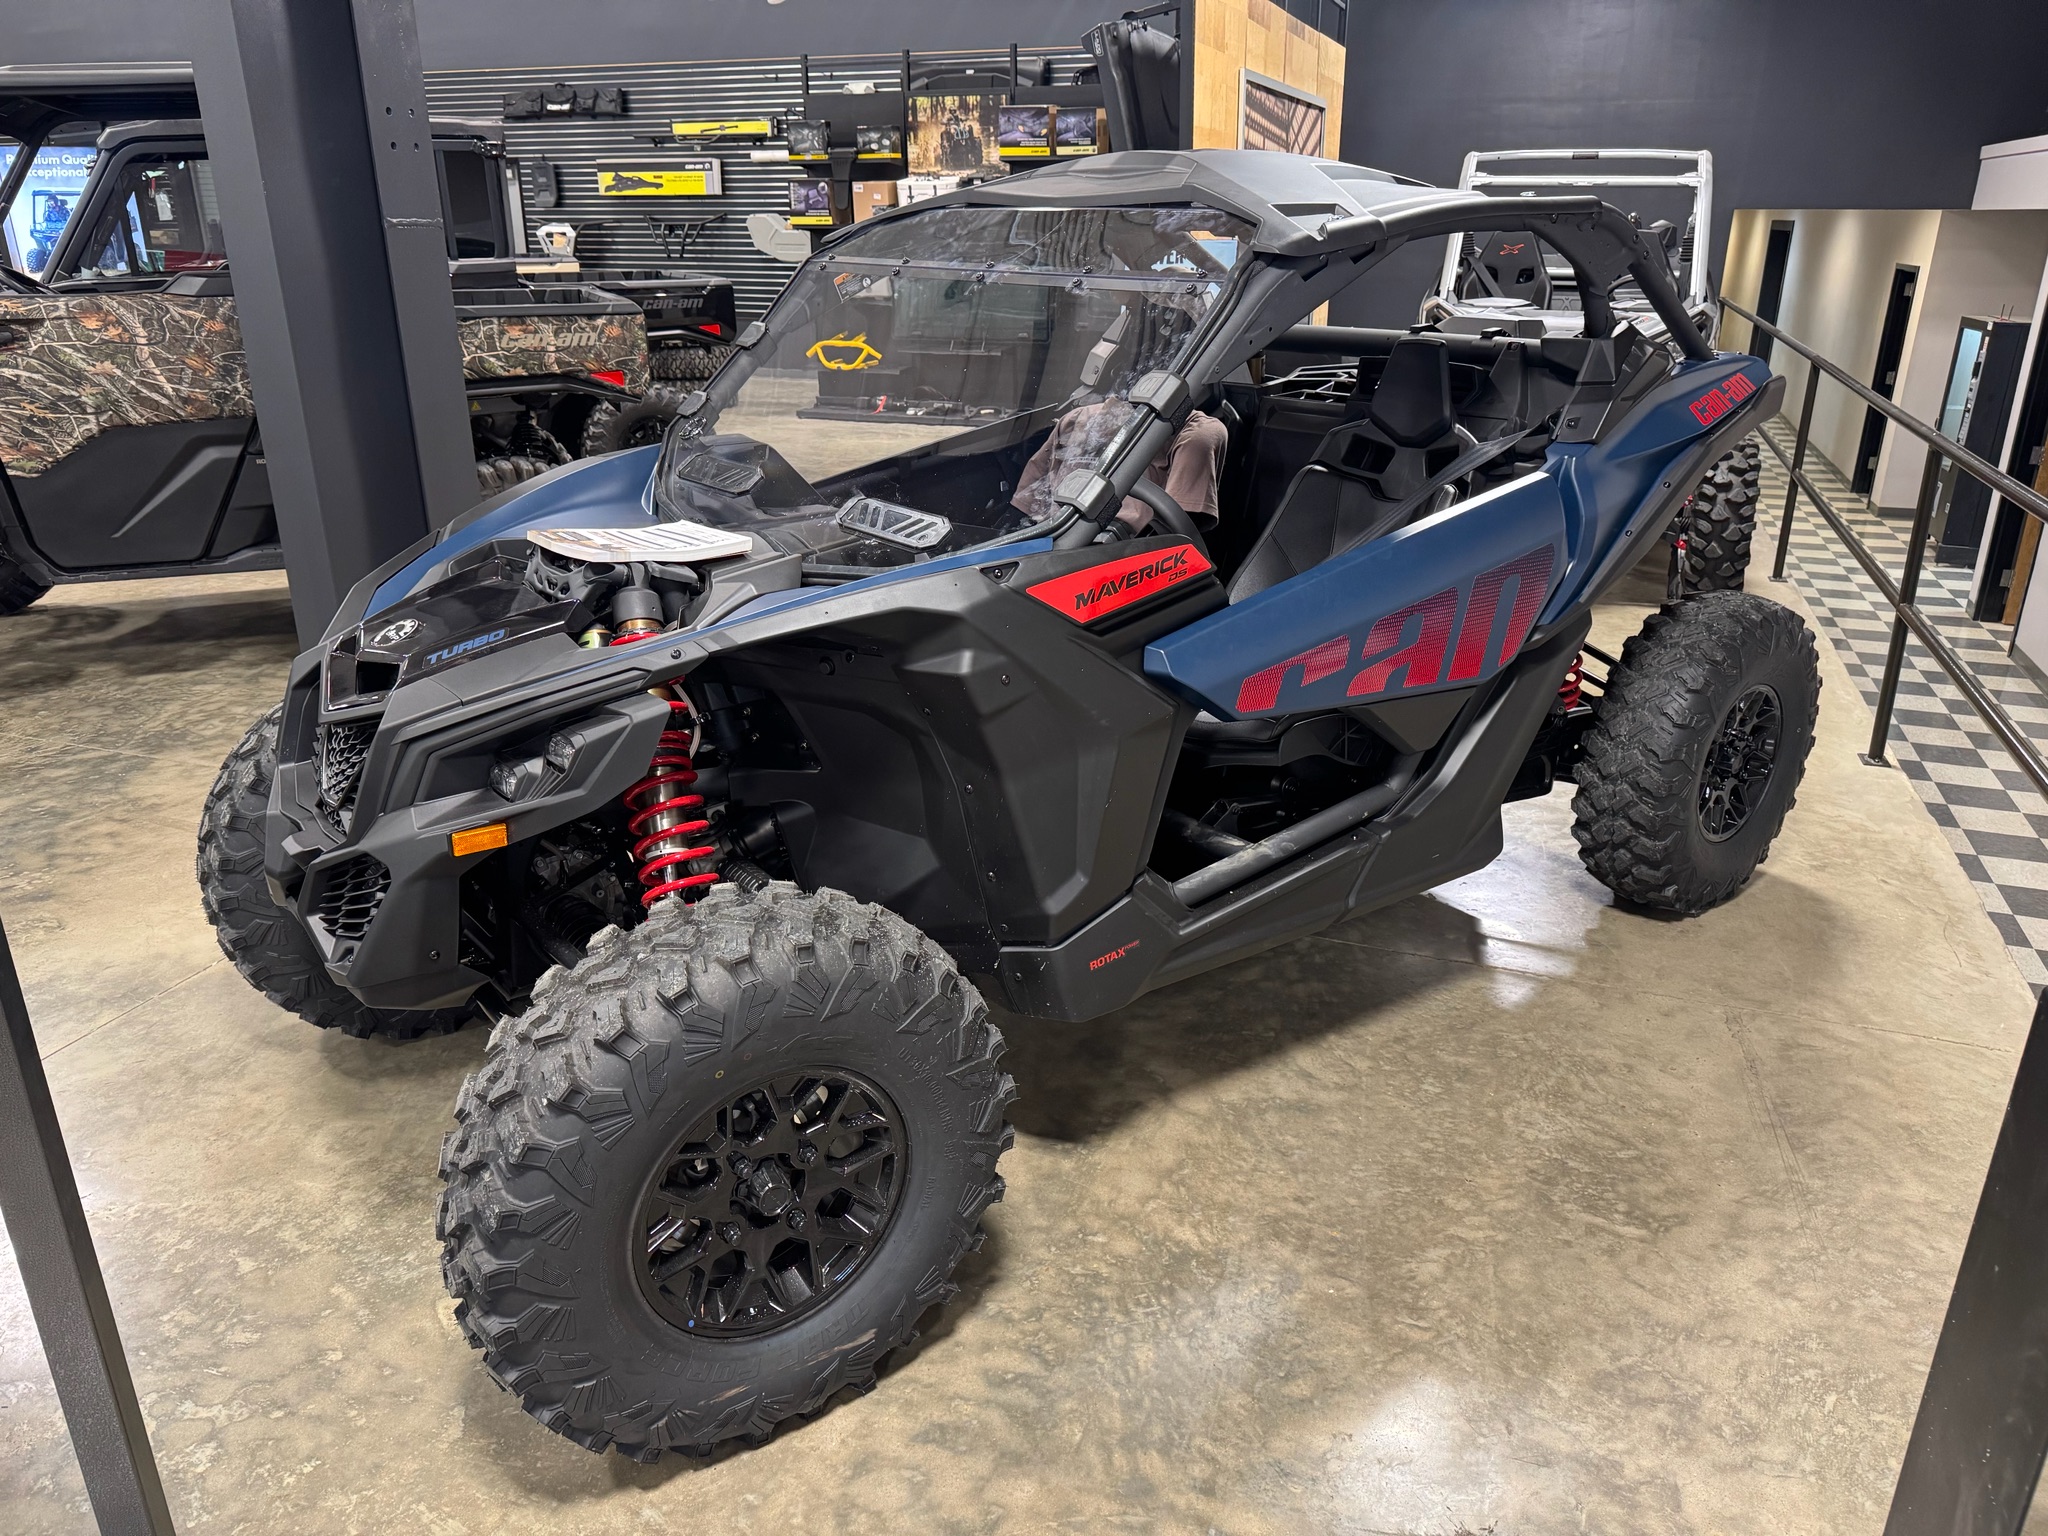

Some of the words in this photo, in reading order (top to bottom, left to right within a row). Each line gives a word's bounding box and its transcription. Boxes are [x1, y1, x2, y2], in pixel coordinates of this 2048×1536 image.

[642, 298, 704, 310] can-am
[501, 333, 597, 348] can-am
[1689, 372, 1757, 426] can-am
[1074, 548, 1189, 611] MAVERICK
[1168, 568, 1188, 582] DS
[426, 629, 506, 665] TURBO
[1089, 947, 1126, 971] ROTAX
